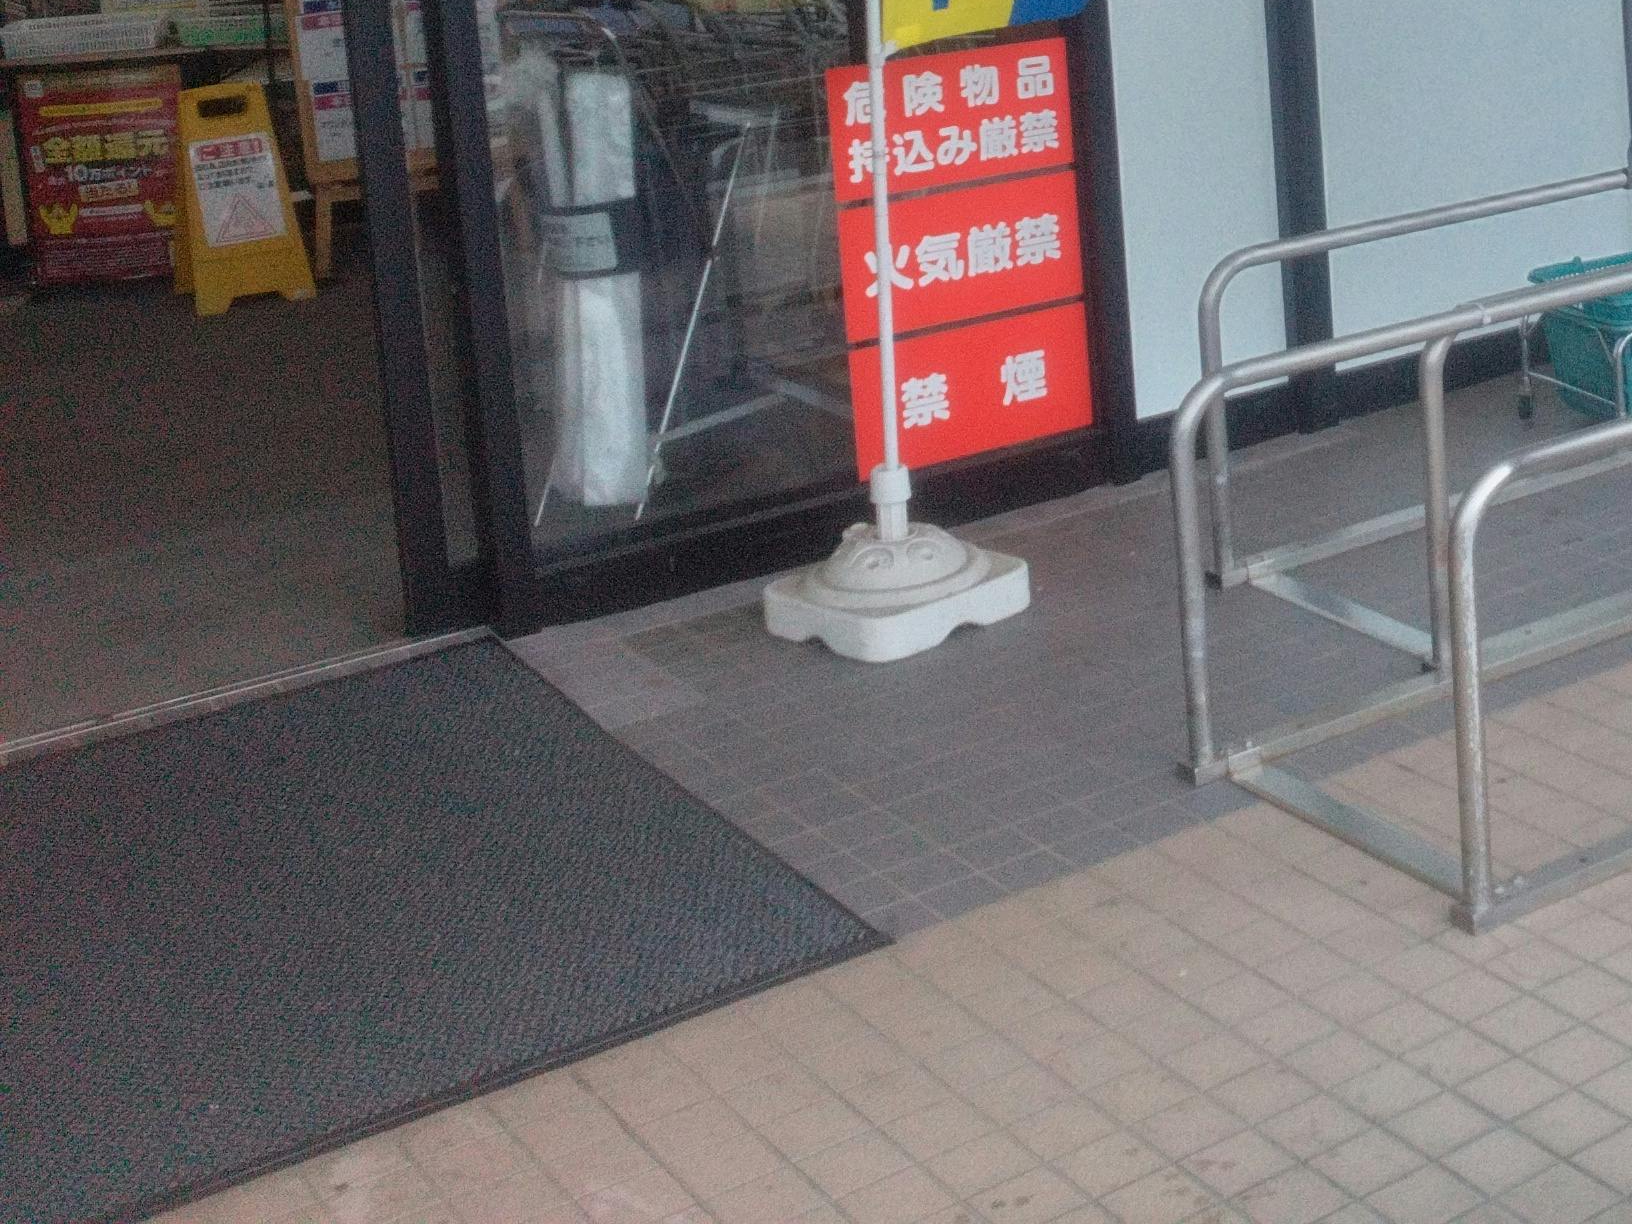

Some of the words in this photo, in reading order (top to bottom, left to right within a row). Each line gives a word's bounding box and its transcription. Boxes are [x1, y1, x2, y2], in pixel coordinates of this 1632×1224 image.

[843, 55, 1054, 127] 危険物品
[848, 109, 1060, 184] 持込み厳禁
[864, 213, 1062, 299] 火気厳禁
